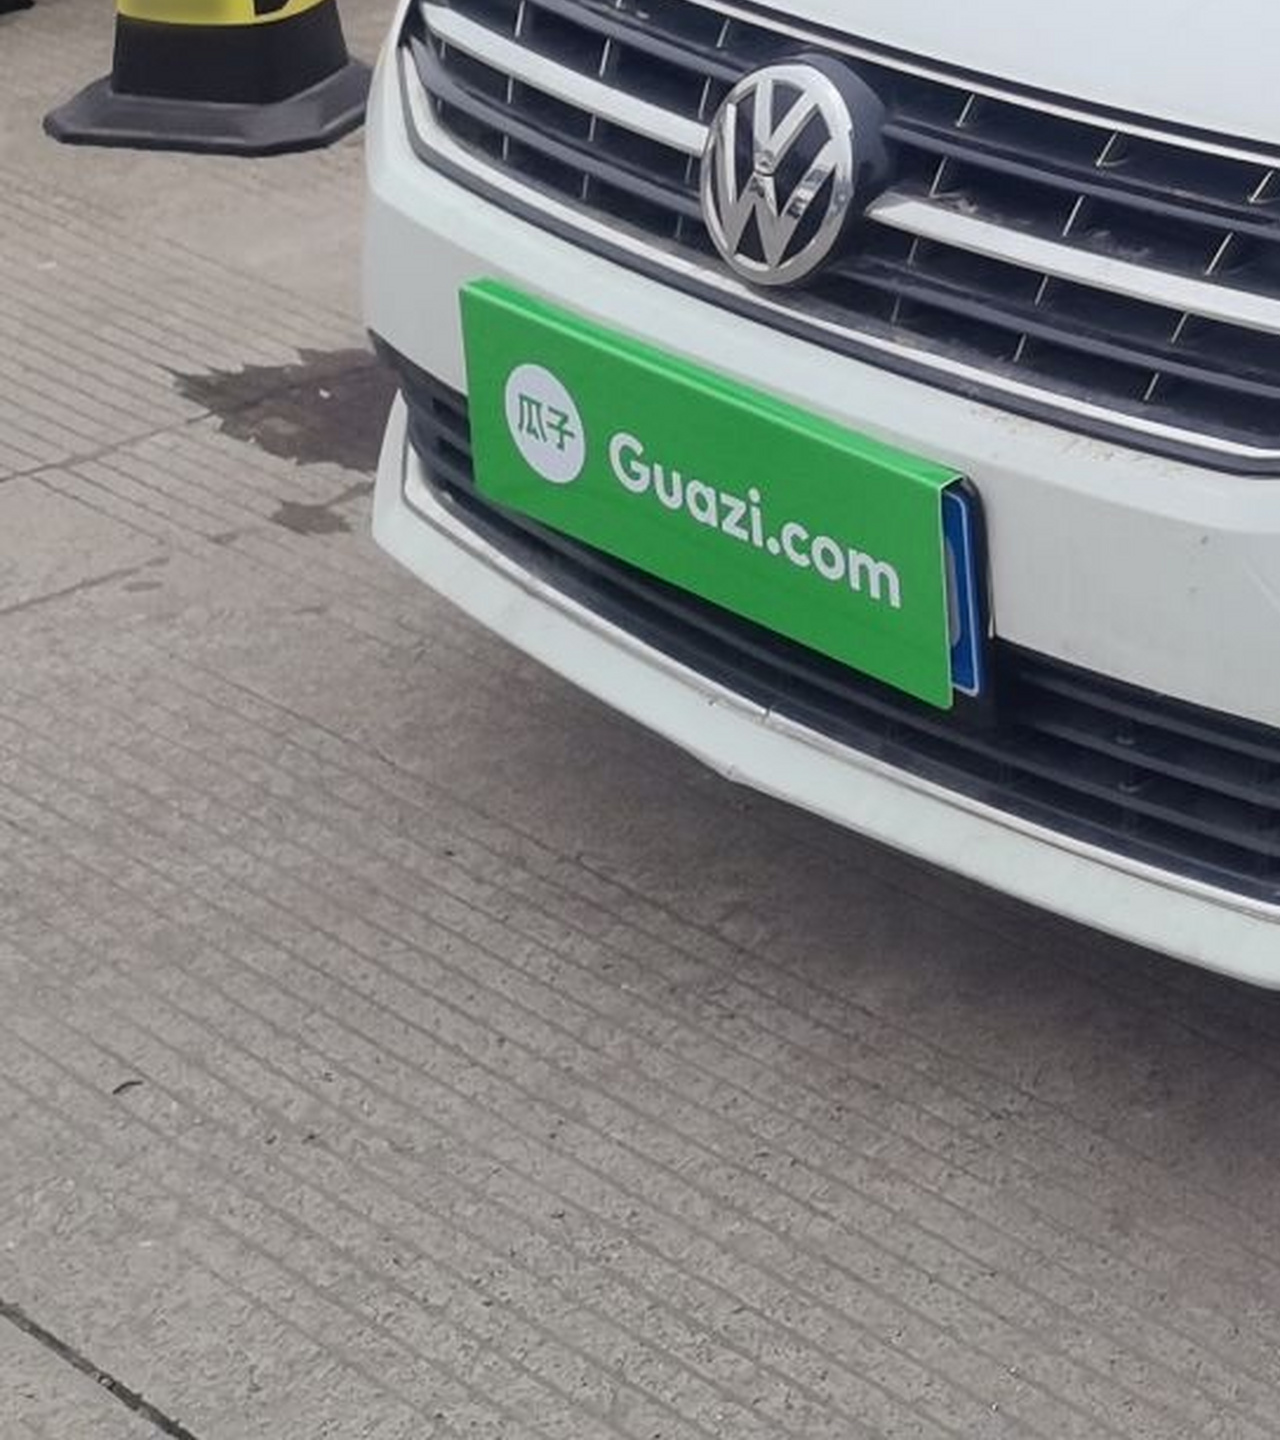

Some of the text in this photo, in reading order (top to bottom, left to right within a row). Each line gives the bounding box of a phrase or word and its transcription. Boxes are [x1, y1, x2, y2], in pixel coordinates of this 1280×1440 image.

[708, 67, 848, 276] VW
[518, 392, 575, 452] 瓜子
[608, 432, 901, 609] Guazi.com
